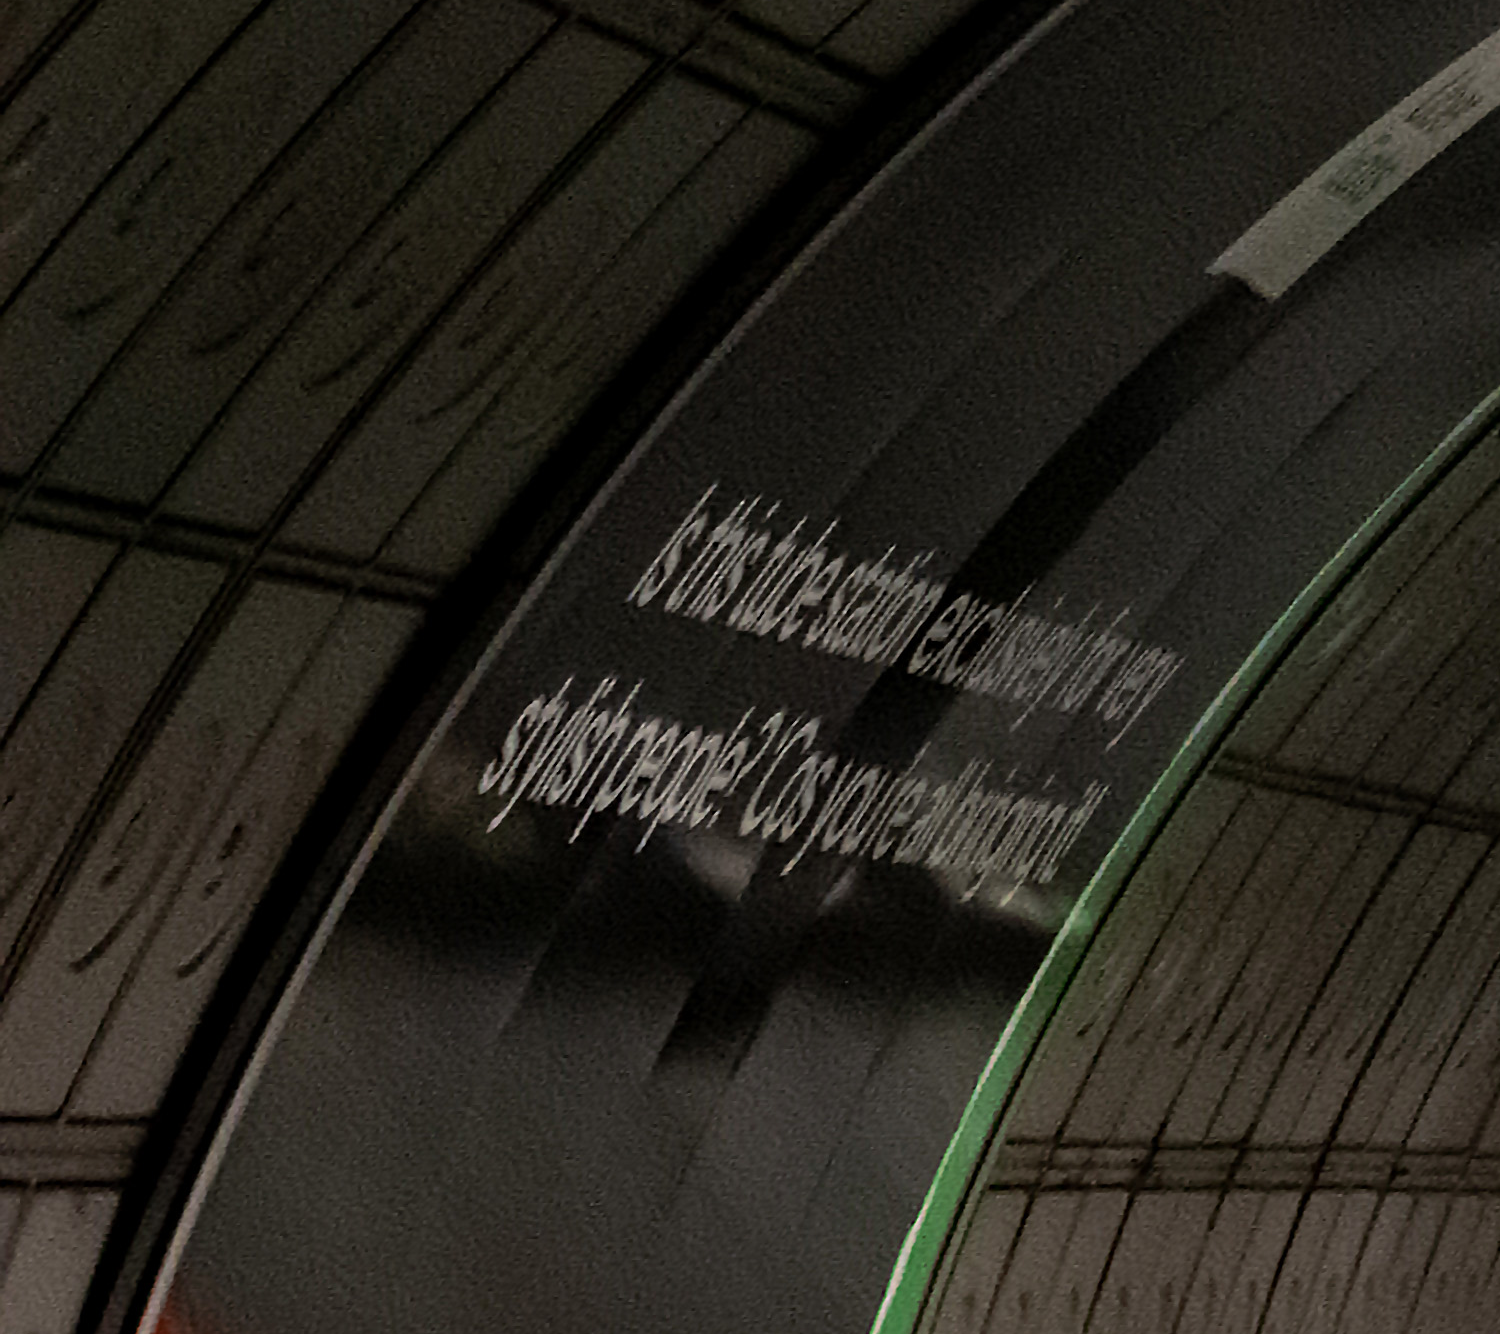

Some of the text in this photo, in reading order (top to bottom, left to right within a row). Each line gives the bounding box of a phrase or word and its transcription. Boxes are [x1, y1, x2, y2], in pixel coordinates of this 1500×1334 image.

[625, 479, 1187, 753] Is this tube station exclusively for very
[478, 673, 645, 833] stylish
[568, 705, 785, 854] people?
[781, 742, 931, 876] you're
[893, 757, 982, 865] all
[928, 758, 1068, 907] bringing
